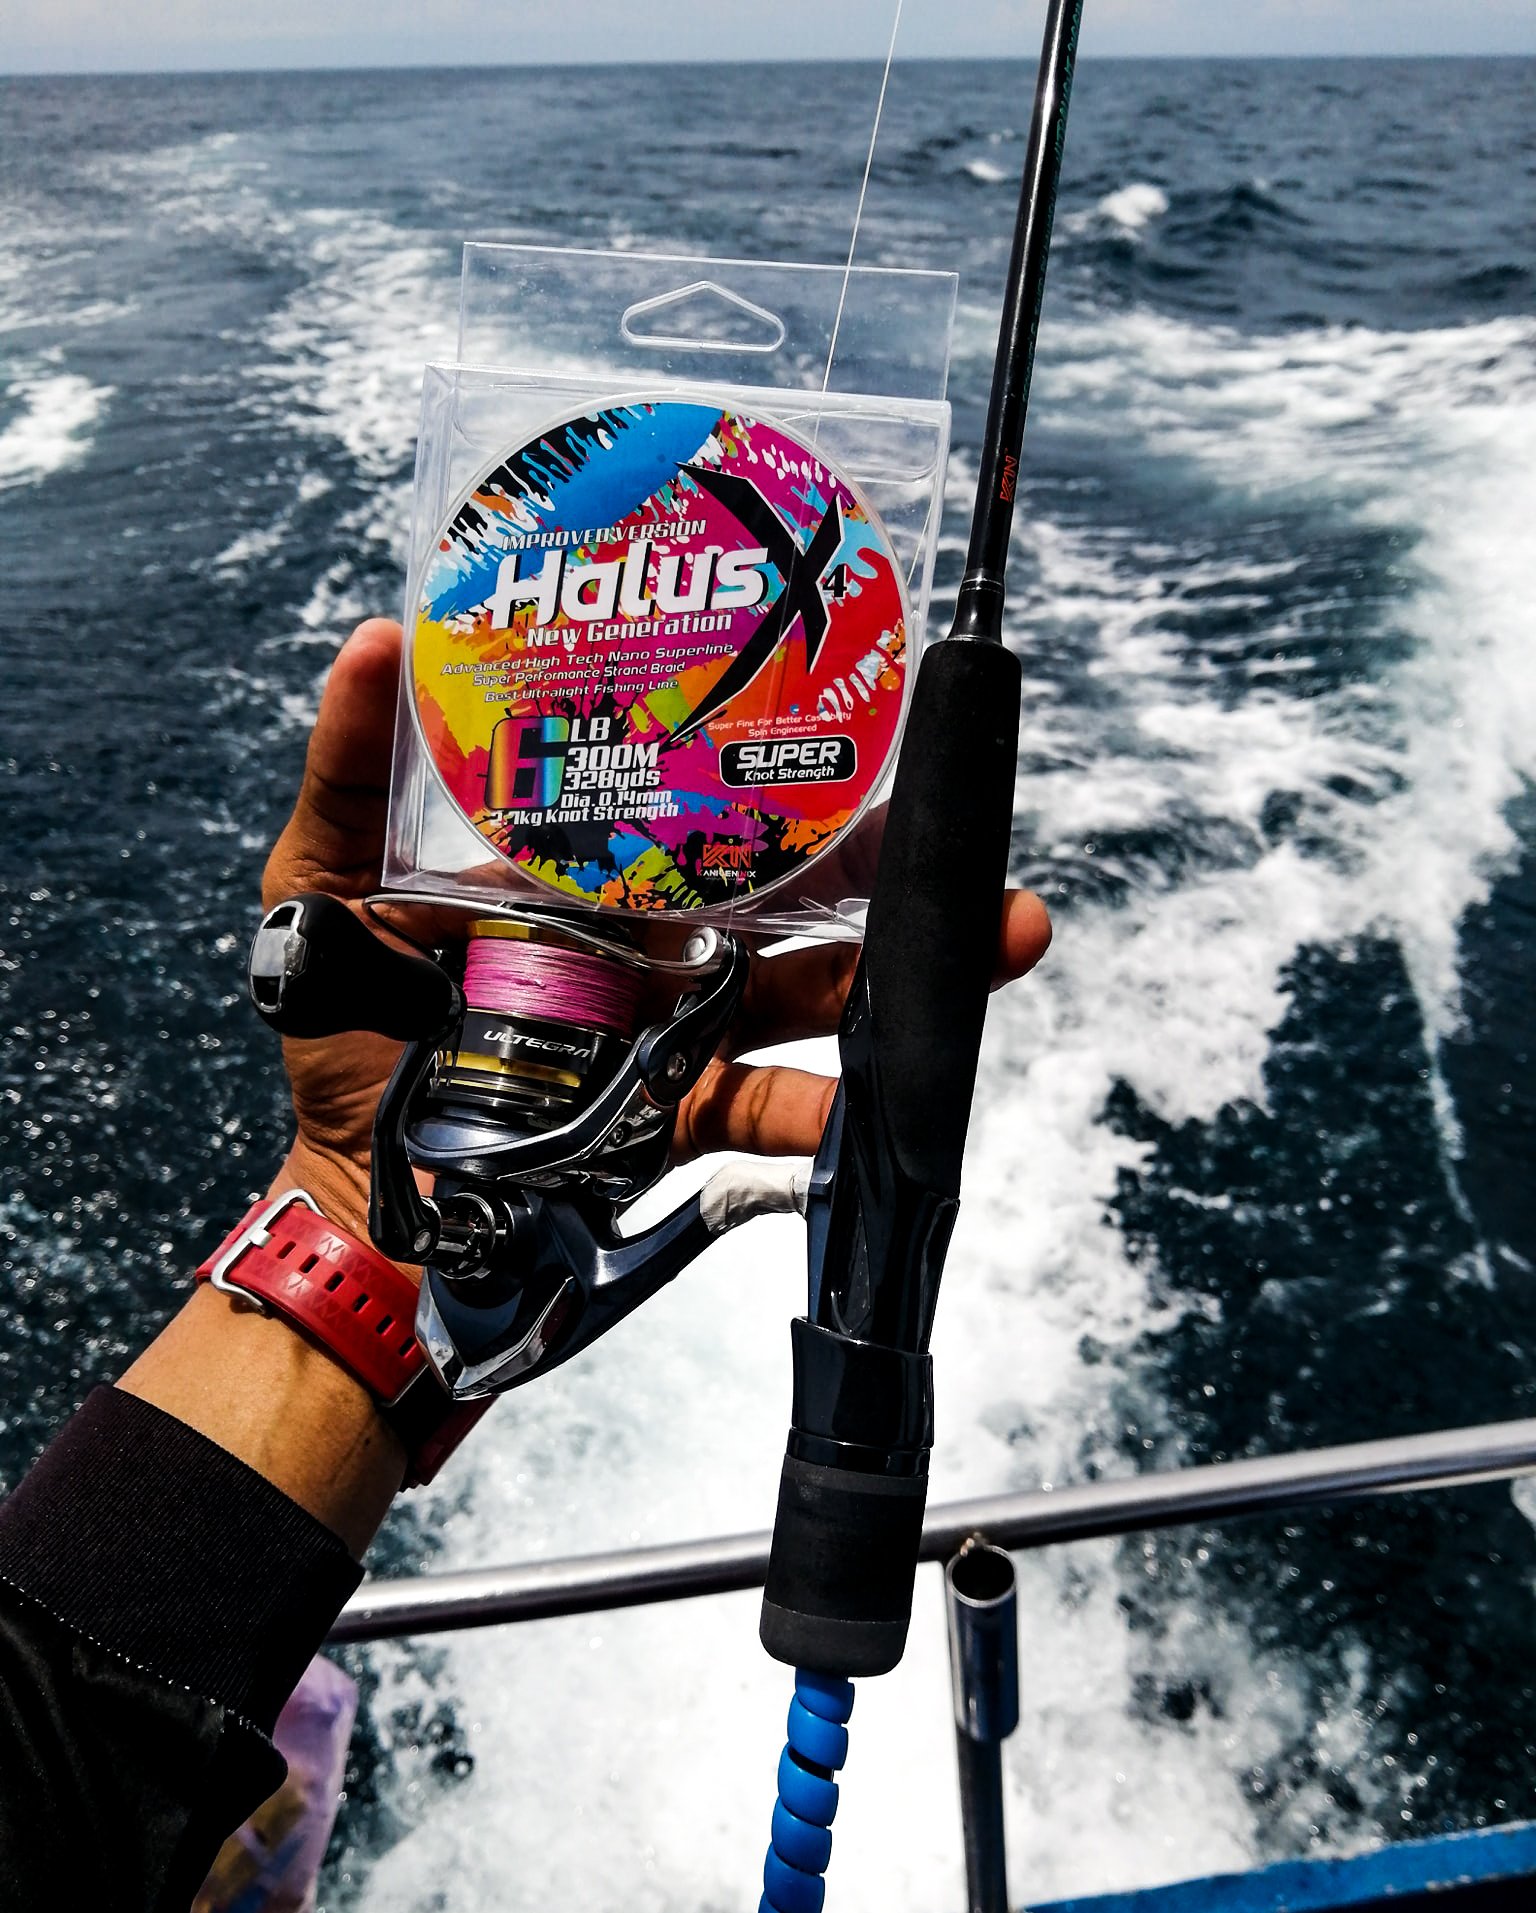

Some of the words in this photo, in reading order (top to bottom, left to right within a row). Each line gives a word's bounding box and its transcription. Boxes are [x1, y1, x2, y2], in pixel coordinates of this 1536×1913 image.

[502, 527, 611, 551] IMPROVED
[615, 519, 707, 540] VERSION
[488, 541, 769, 630] Halus
[526, 625, 583, 648] New
[587, 612, 732, 643] Generation
[441, 659, 521, 675] Advanced
[525, 656, 560, 670] High
[566, 653, 604, 665] Tech
[608, 651, 650, 662] Nano
[655, 643, 734, 659] Superline
[473, 674, 511, 688] Super
[603, 664, 648, 677] Strand
[650, 661, 686, 674] Braid
[484, 691, 518, 702] Best
[522, 685, 589, 700] Ultralight
[593, 681, 645, 695] Fishing
[648, 680, 678, 691] Line
[570, 716, 611, 743] LB
[708, 722, 734, 732] Super
[736, 719, 754, 728] Fine
[757, 718, 773, 727] For
[775, 715, 803, 725] Better
[748, 727, 768, 738] Spin
[770, 724, 818, 736] Engineered
[565, 743, 660, 772] 300M
[736, 741, 841, 769] SUPER
[563, 768, 661, 791] 328yds
[744, 769, 775, 782] Knot
[777, 765, 835, 780] Strength
[560, 794, 596, 808] Dia.
[598, 790, 673, 806] 0.14mm
[545, 808, 590, 824] Knot
[593, 803, 679, 821] Strength
[483, 1030, 592, 1058] ULTEGRA
